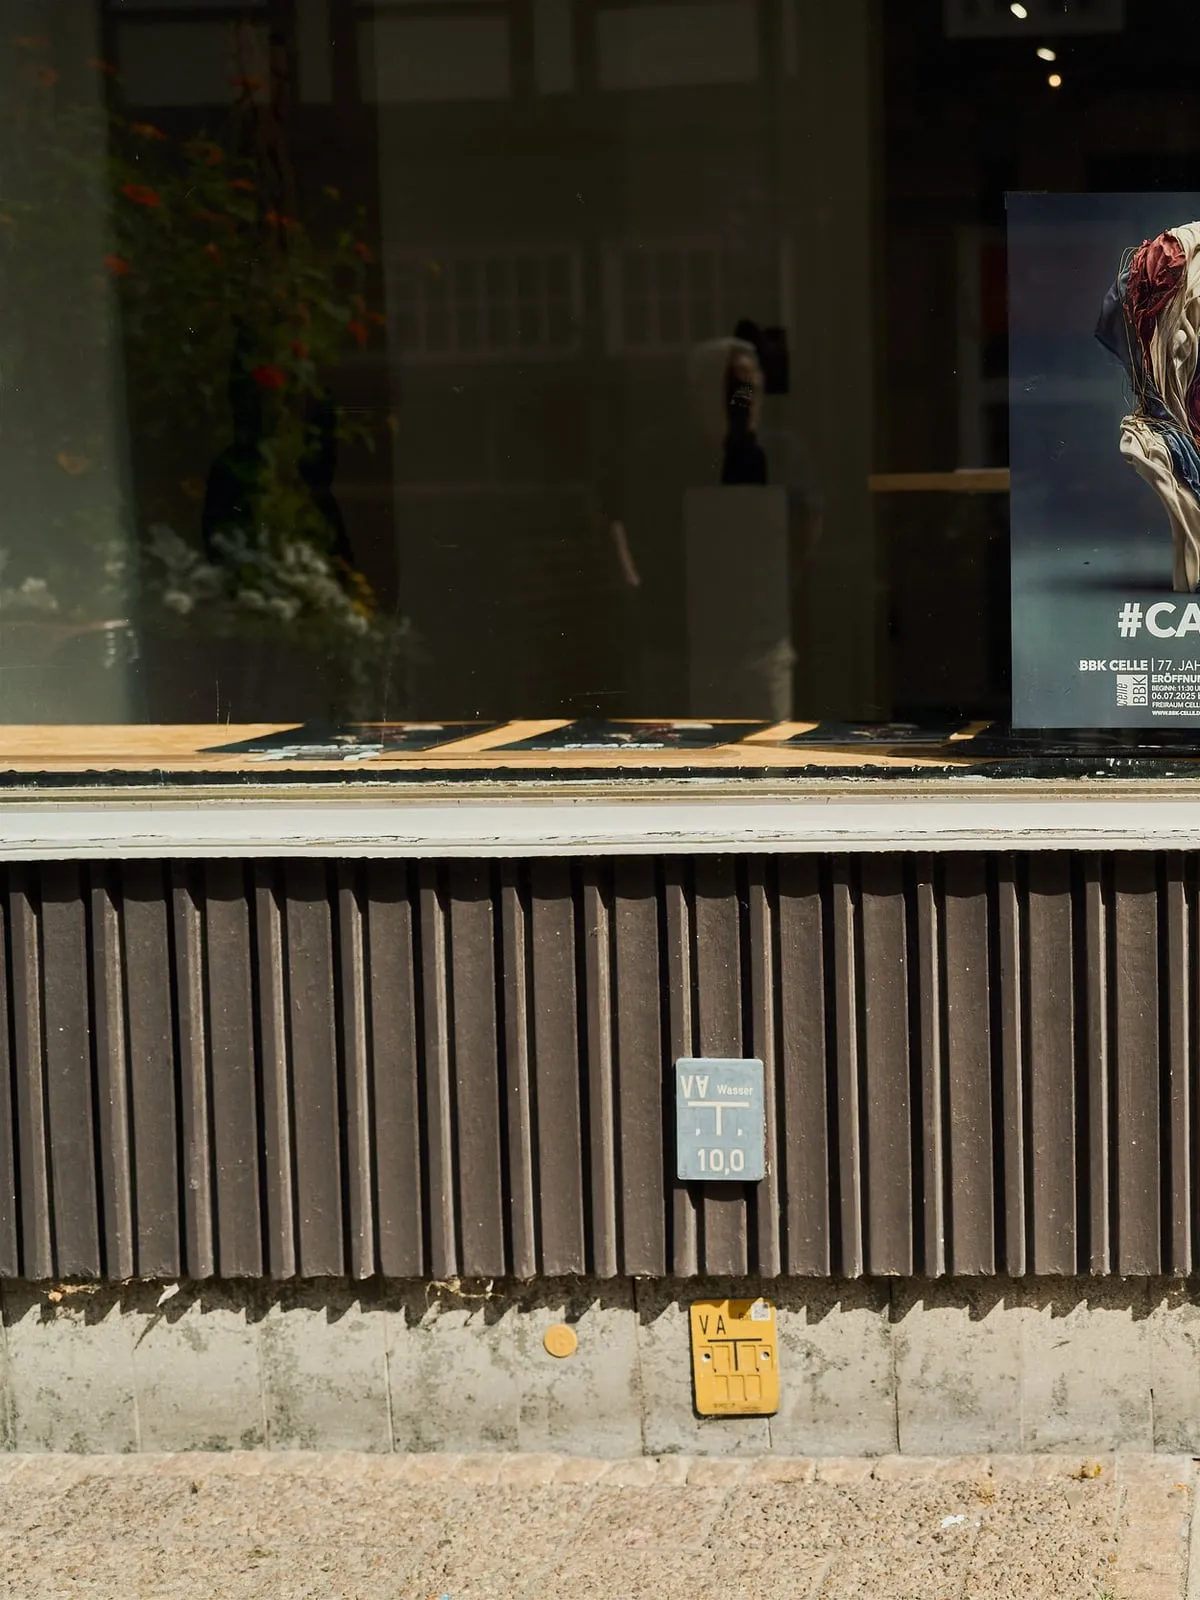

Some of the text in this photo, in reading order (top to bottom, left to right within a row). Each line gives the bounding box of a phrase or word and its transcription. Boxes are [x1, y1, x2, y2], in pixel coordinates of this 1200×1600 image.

[1079, 659, 1107, 671] BBK
[1109, 659, 1148, 671] CELLE
[1158, 660, 1176, 671] 77.
[1132, 676, 1146, 704] BBK
[1151, 692, 1196, 700] 06.07.2025
[717, 1084, 753, 1096] Wasser
[697, 1148, 745, 1176] 10,0
